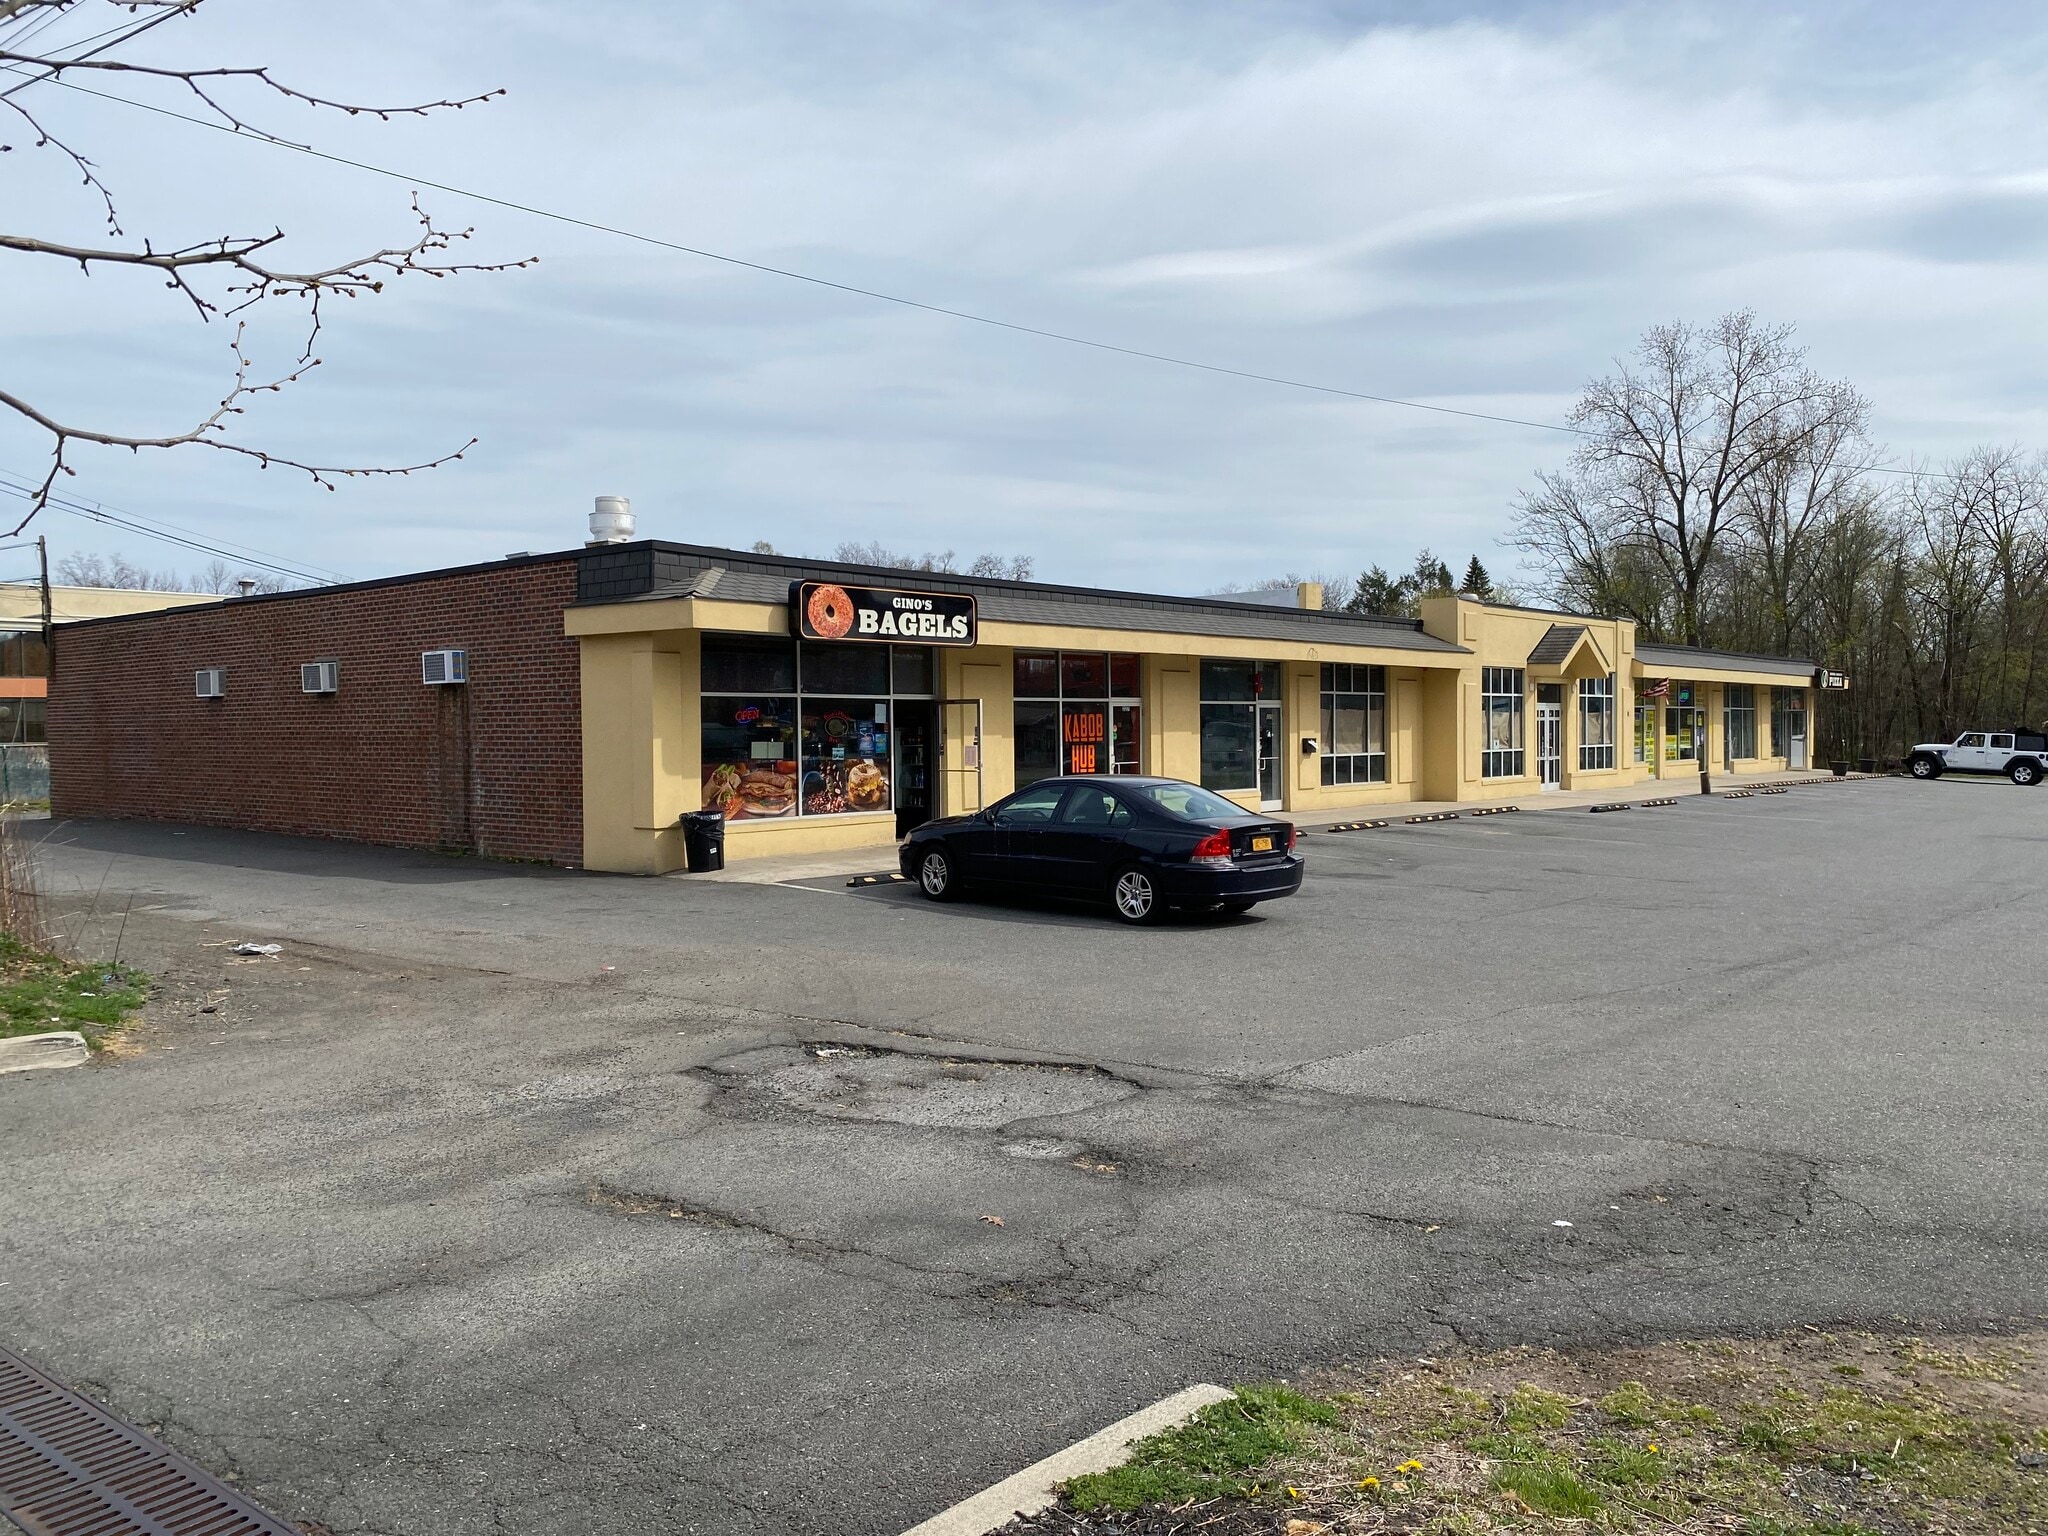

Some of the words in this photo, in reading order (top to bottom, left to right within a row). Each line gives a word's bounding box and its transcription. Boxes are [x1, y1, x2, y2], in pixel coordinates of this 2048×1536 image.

[892, 597, 933, 611] GINO'S
[858, 608, 968, 639] BAGELS
[735, 709, 760, 721] OPEN
[1064, 713, 1104, 742] KABOB
[1071, 744, 1096, 773] HUB
